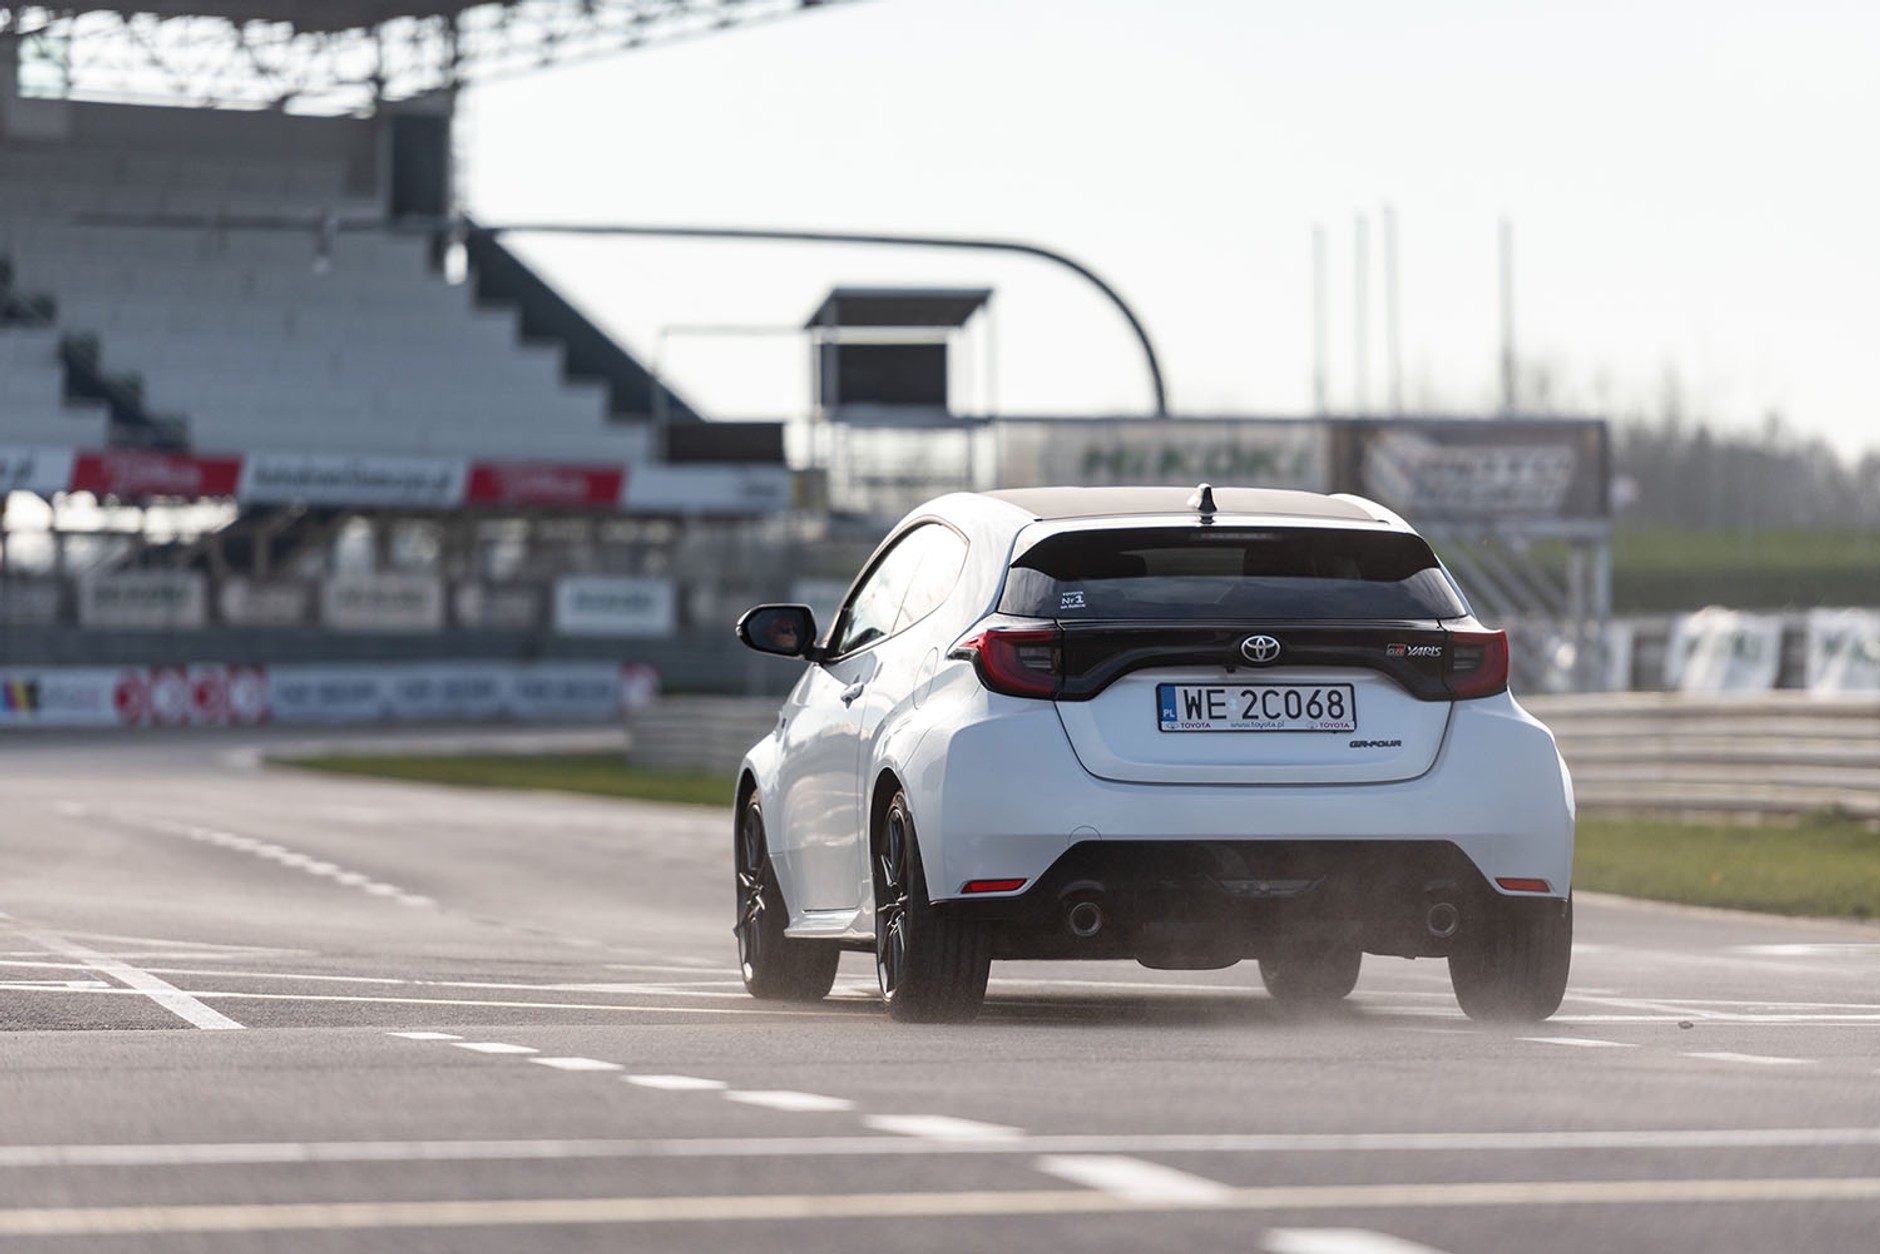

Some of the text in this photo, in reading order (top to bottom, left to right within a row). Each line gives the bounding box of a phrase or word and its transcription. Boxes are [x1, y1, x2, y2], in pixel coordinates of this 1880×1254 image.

[1407, 646, 1442, 656] YARIS
[1183, 689, 1345, 720] WE 2C068
[1163, 708, 1175, 718] PL
[1230, 721, 1285, 729] www.toyota.pl
